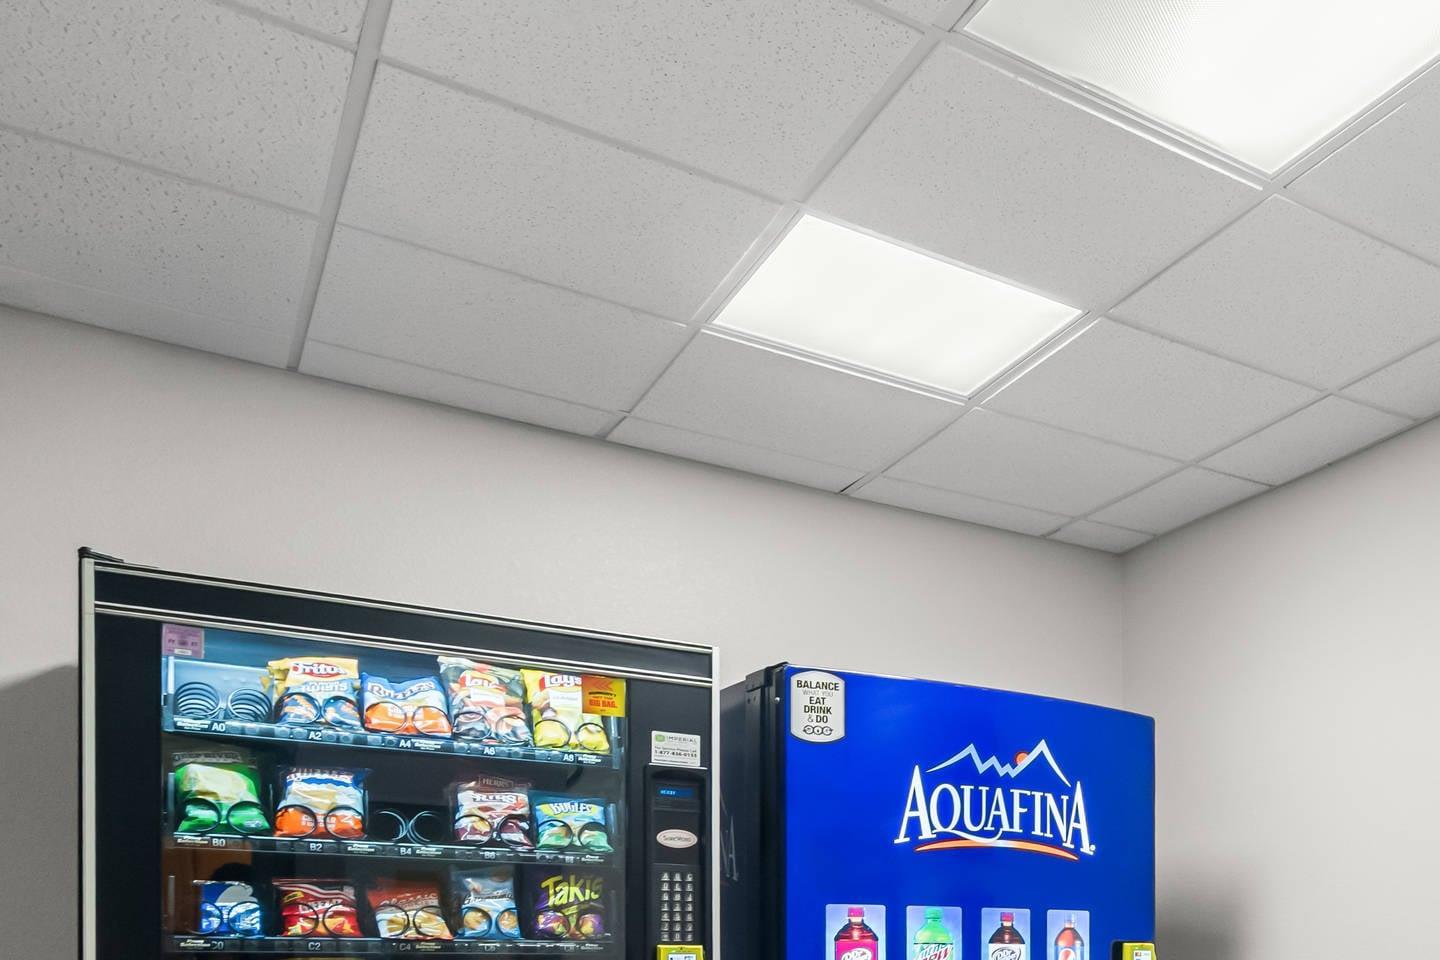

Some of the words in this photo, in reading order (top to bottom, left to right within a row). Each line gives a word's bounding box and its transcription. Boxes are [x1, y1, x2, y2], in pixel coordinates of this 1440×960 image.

[796, 680, 840, 691] BALANCE
[809, 696, 827, 705] EAT
[803, 705, 832, 715] DRINK
[807, 714, 814, 723] &
[815, 715, 828, 724] DO
[308, 731, 322, 741] A2
[399, 739, 411, 748] A4
[893, 764, 1094, 855] AQUAFINA
[212, 838, 226, 847] B0
[309, 843, 323, 851] B2
[400, 847, 412, 855] B4
[540, 873, 604, 908] Takis
[308, 941, 321, 950] C2
[399, 943, 411, 951] C4
